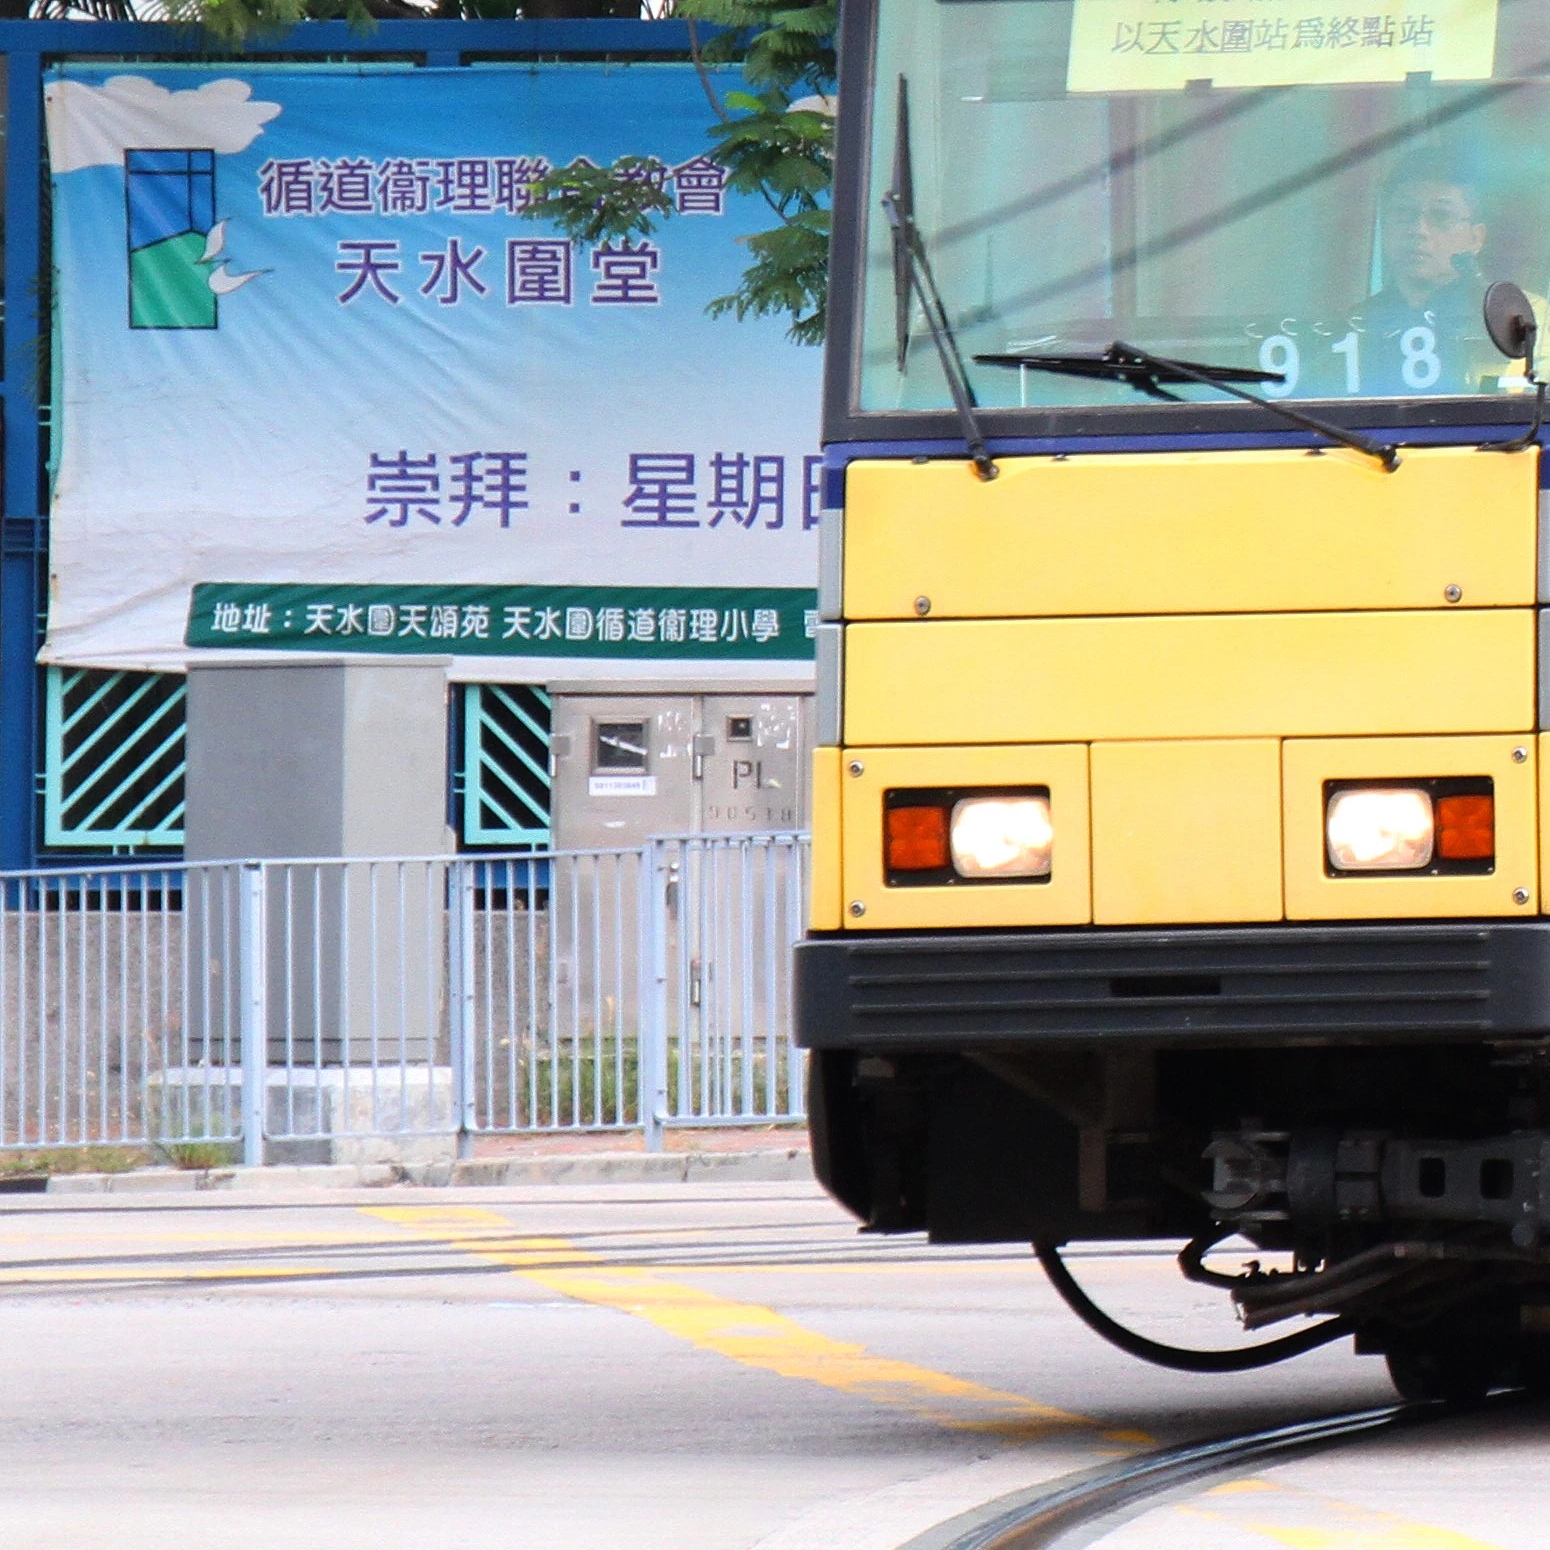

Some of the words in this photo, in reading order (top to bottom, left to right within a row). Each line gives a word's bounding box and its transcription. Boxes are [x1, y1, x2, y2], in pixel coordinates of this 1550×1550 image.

[336, 237, 661, 306] 天水圍堂
[1257, 325, 1442, 399] 918
